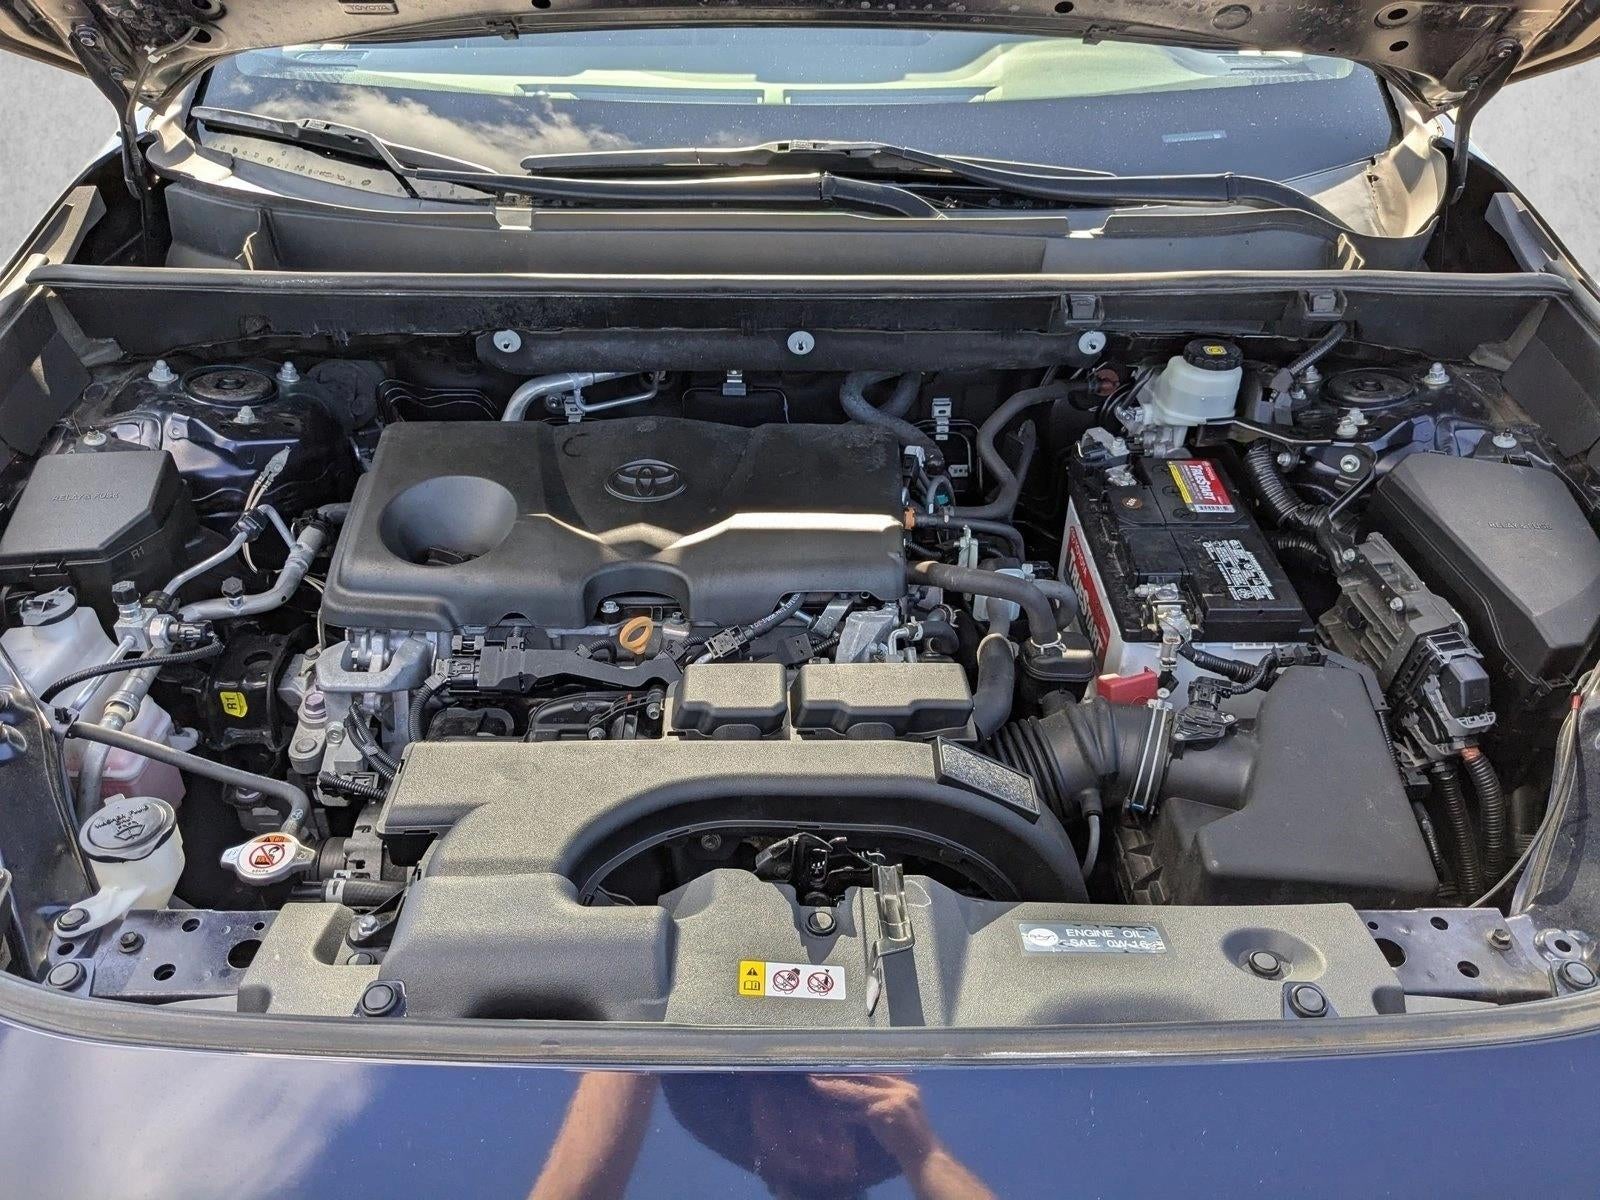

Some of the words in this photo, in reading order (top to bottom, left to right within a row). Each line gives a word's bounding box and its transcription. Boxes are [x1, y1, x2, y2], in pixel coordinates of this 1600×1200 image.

[345, 3, 390, 11] TOYOTA
[225, 697, 238, 710] R1
[1065, 928, 1117, 938] ENGINE
[1122, 929, 1146, 939] OIL
